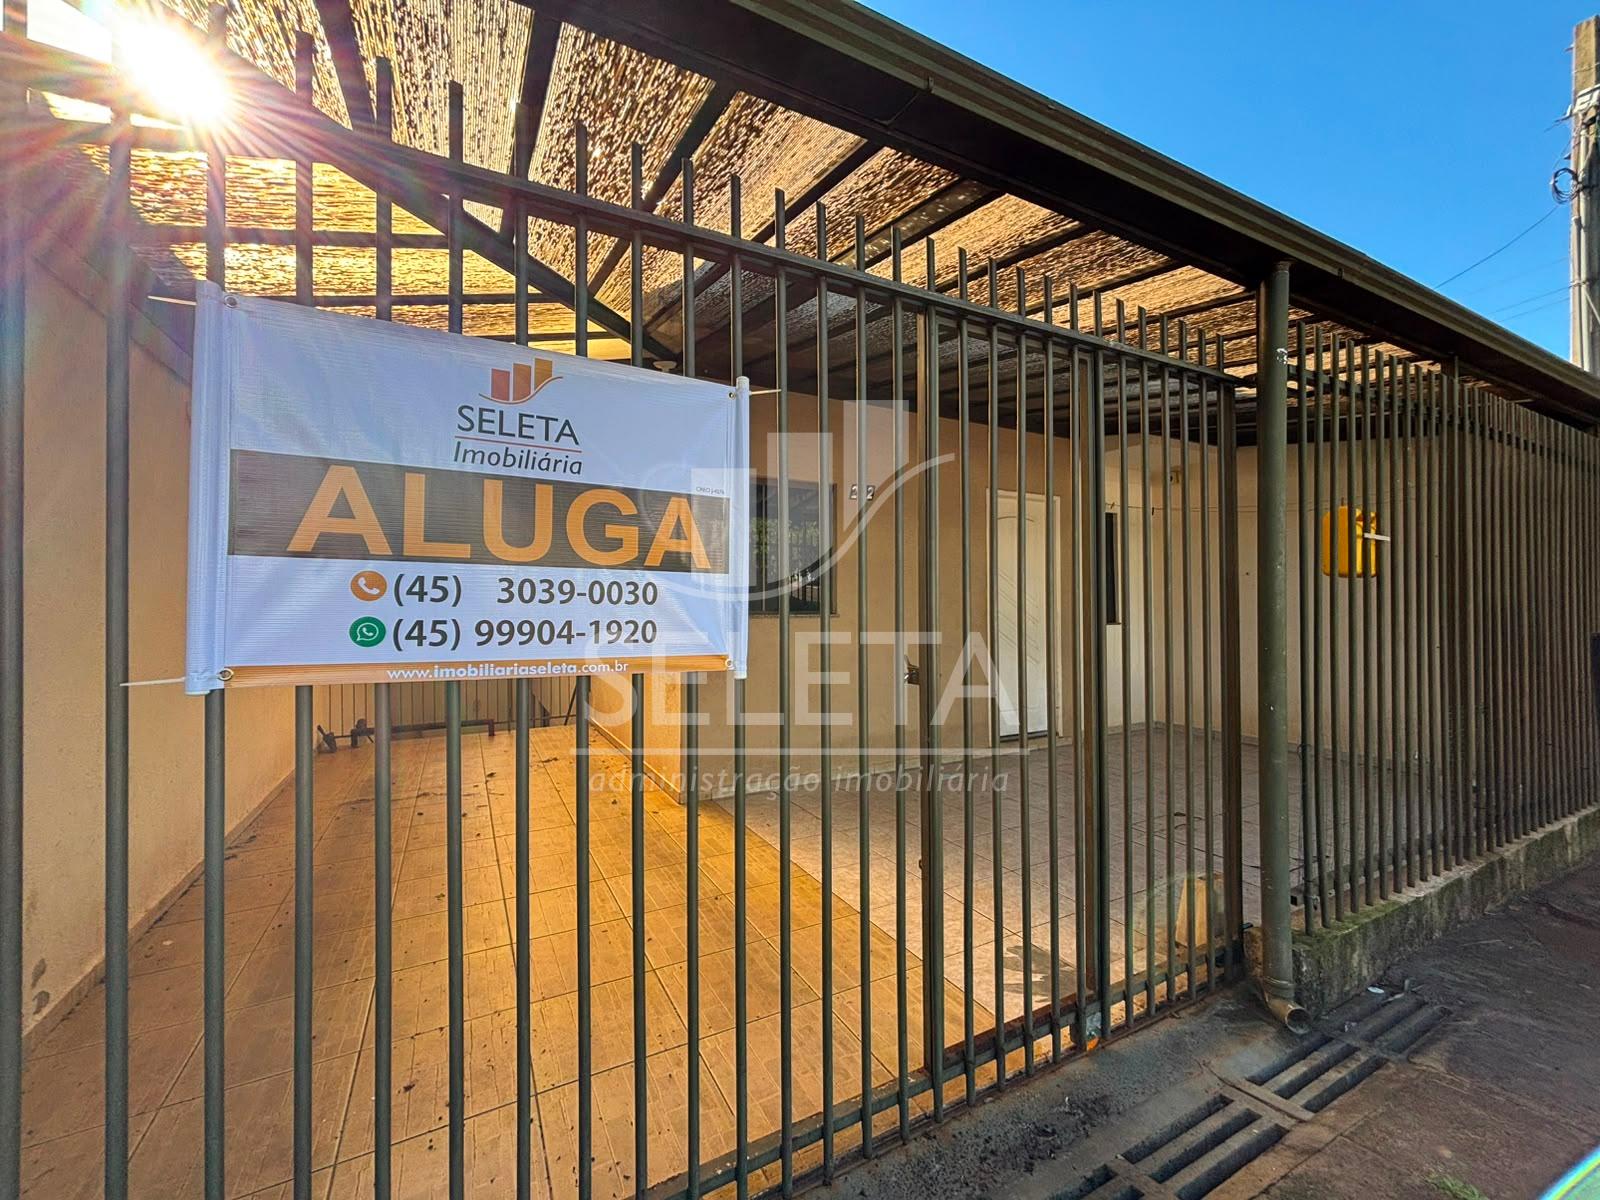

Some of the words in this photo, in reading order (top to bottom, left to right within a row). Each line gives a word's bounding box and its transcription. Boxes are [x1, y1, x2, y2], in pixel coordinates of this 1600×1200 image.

[457, 405, 579, 445] SELETA
[453, 441, 582, 475] Imobiliária
[286, 465, 711, 569] ALUGA
[393, 574, 462, 607] (45)
[496, 577, 658, 605] 3039-0030
[392, 618, 461, 651] (45)
[474, 619, 657, 647] 99904-1920
[387, 660, 629, 679] www.imobiliariaseleta.com.br
